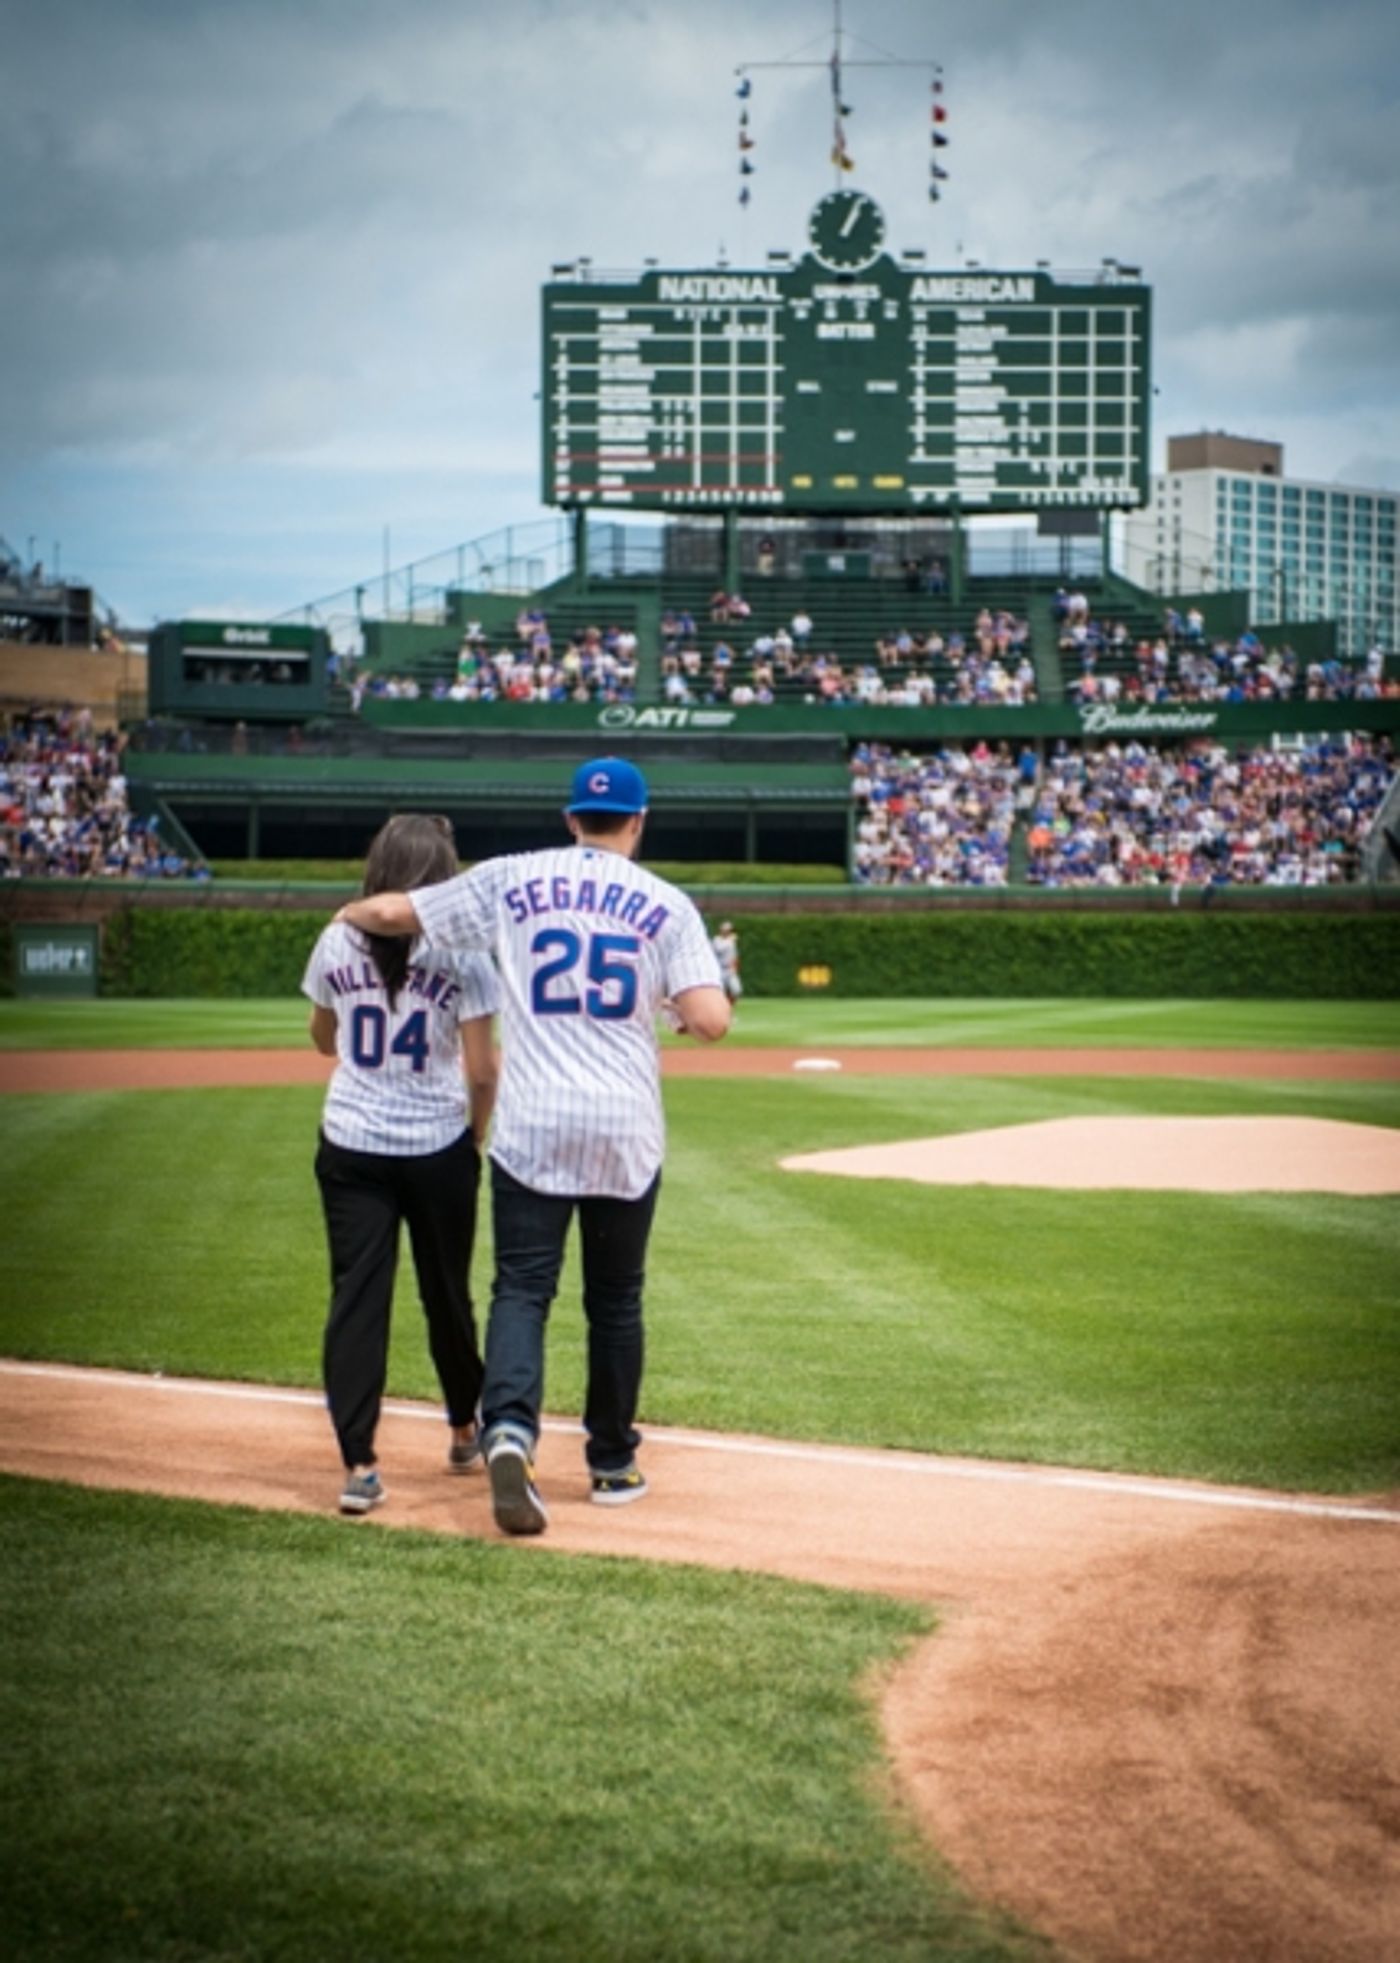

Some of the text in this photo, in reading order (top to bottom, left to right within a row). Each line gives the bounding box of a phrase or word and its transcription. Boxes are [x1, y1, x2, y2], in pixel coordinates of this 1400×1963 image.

[659, 277, 784, 301] NATIONAL
[910, 277, 1035, 301] AMERICAN
[634, 706, 689, 727] ATI
[1080, 704, 1218, 733] Budweiser
[589, 772, 610, 794] C
[504, 876, 670, 940] SEGARRA
[530, 928, 640, 1021] 25
[352, 1003, 430, 1075] 04
